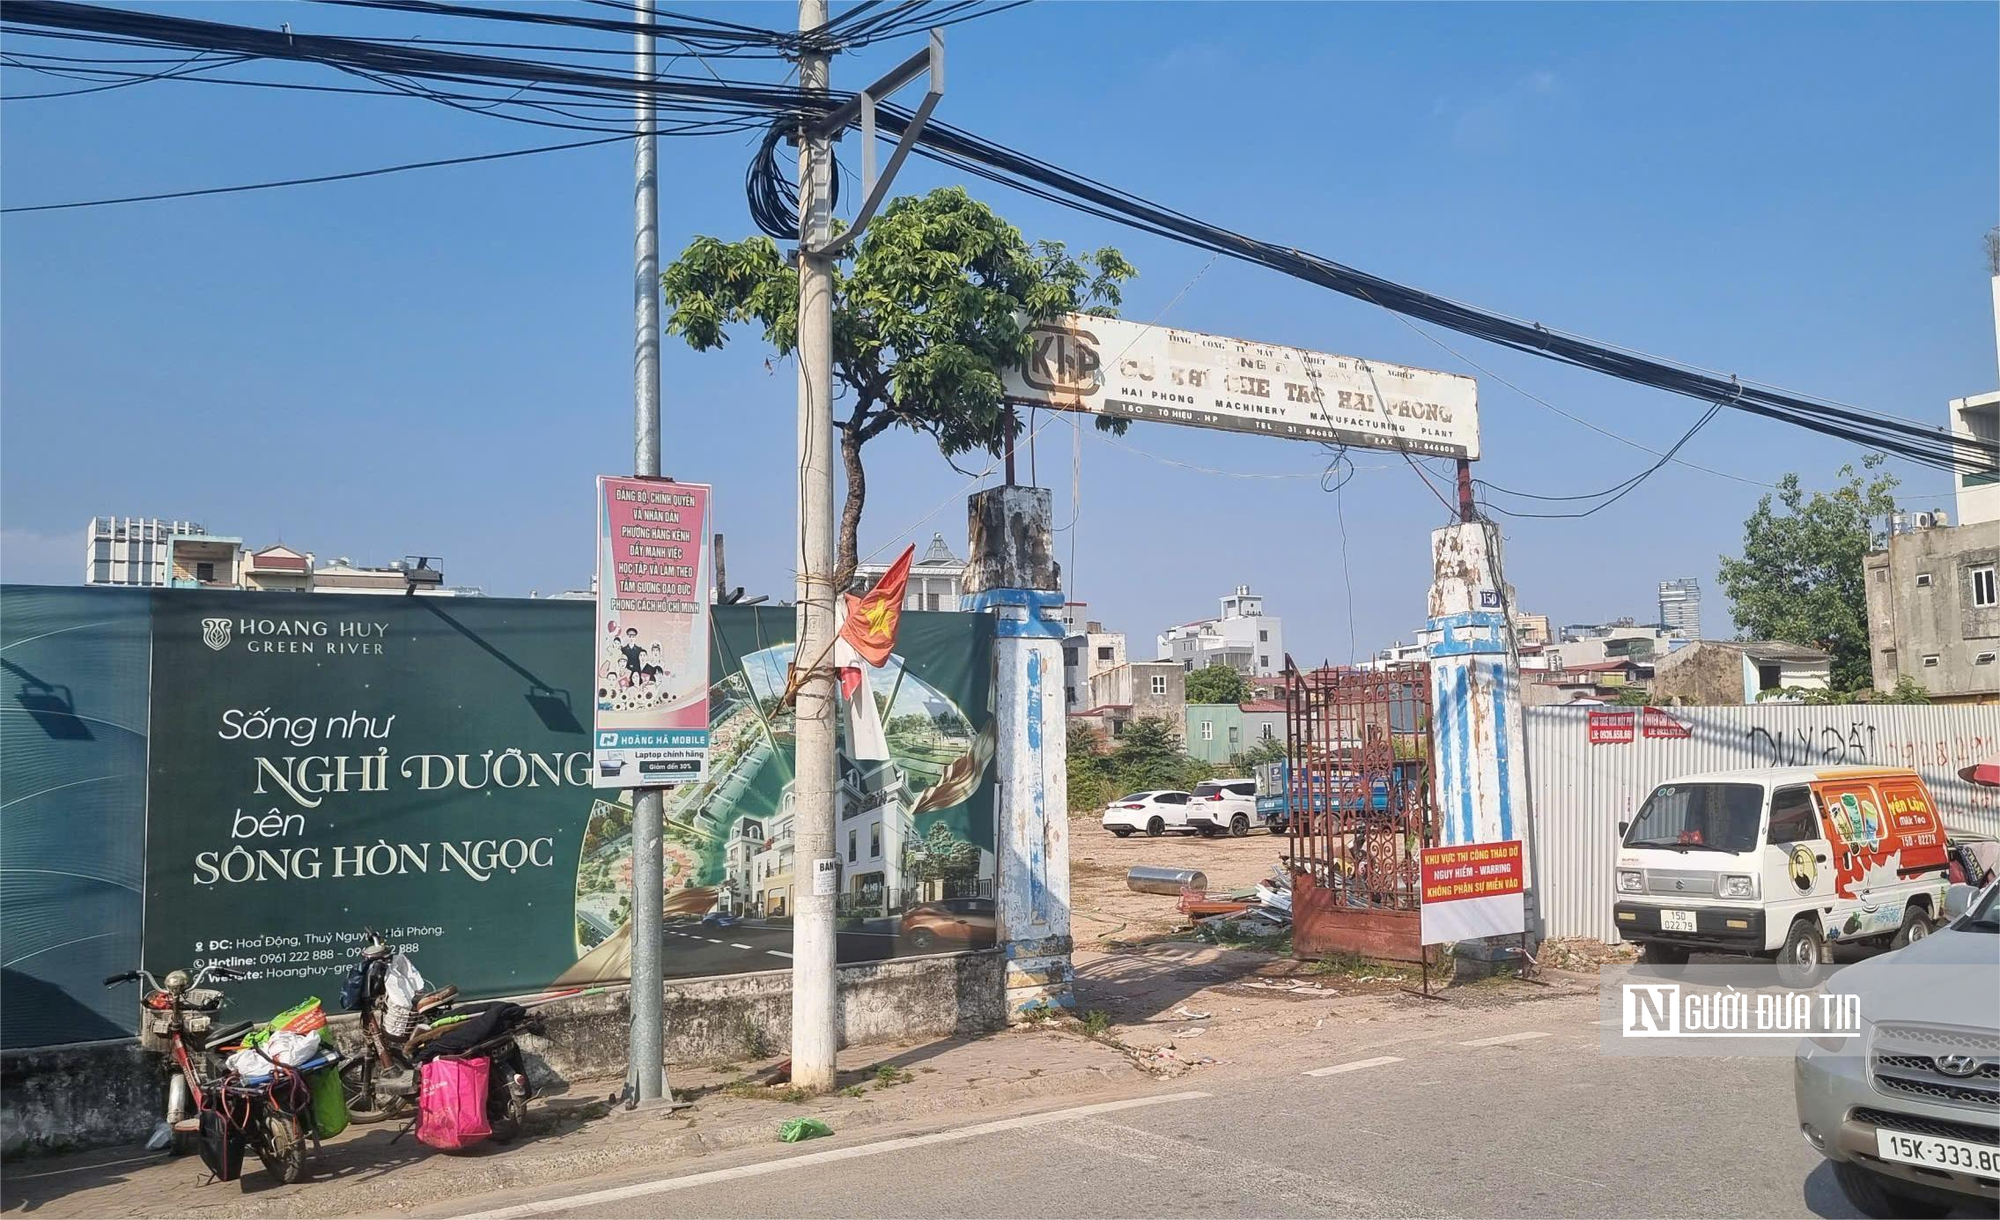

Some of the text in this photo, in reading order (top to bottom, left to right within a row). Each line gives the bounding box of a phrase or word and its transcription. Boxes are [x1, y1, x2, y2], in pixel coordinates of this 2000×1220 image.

[1121, 387, 1454, 438] HAI PHONG MACHINERY MANUFACTURING PLANT
[650, 490, 672, 505] CHÍNH
[633, 507, 643, 520] VÀ
[644, 508, 664, 522] NHÂN
[621, 524, 650, 539] PHƯỜNG
[645, 546, 666, 560] MẠNH
[667, 546, 683, 561] VIỆC
[618, 561, 693, 578] HỌC TẬP VÀ LÀM THEO
[619, 577, 636, 592] TẤM
[637, 580, 661, 594] GƯƠNG
[611, 597, 700, 614] PHONG CÁCH HỒ CHÍ MINH
[1483, 593, 1497, 605] 150
[240, 619, 390, 638] HOANG HUY
[247, 641, 384, 655] GREEN RIVER
[218, 706, 396, 747] Sống như
[621, 734, 654, 745] HOÀNG
[671, 736, 705, 745] MOBILE
[635, 750, 704, 760] Laptop chính hãng
[253, 746, 593, 808] NGHỈ DƯỠNG
[231, 808, 306, 840] bên
[193, 837, 554, 885] SÔNG HÒN NGỌC
[1424, 855, 1440, 866] KHU
[1441, 853, 1456, 865] VỰC
[1457, 852, 1469, 862] THI
[1470, 850, 1489, 861] CÔNG
[1434, 869, 1454, 881] NGUY
[1427, 885, 1452, 898] KHÔNG
[1504, 877, 1519, 889] VÀO
[1664, 920, 1693, 931] 022.79
[209, 939, 233, 951] ĐC:
[407, 926, 445, 940] Phòng.
[209, 954, 257, 968] Hotline:
[260, 953, 287, 965] 0961
[289, 951, 310, 963] 222
[313, 949, 334, 961] 888
